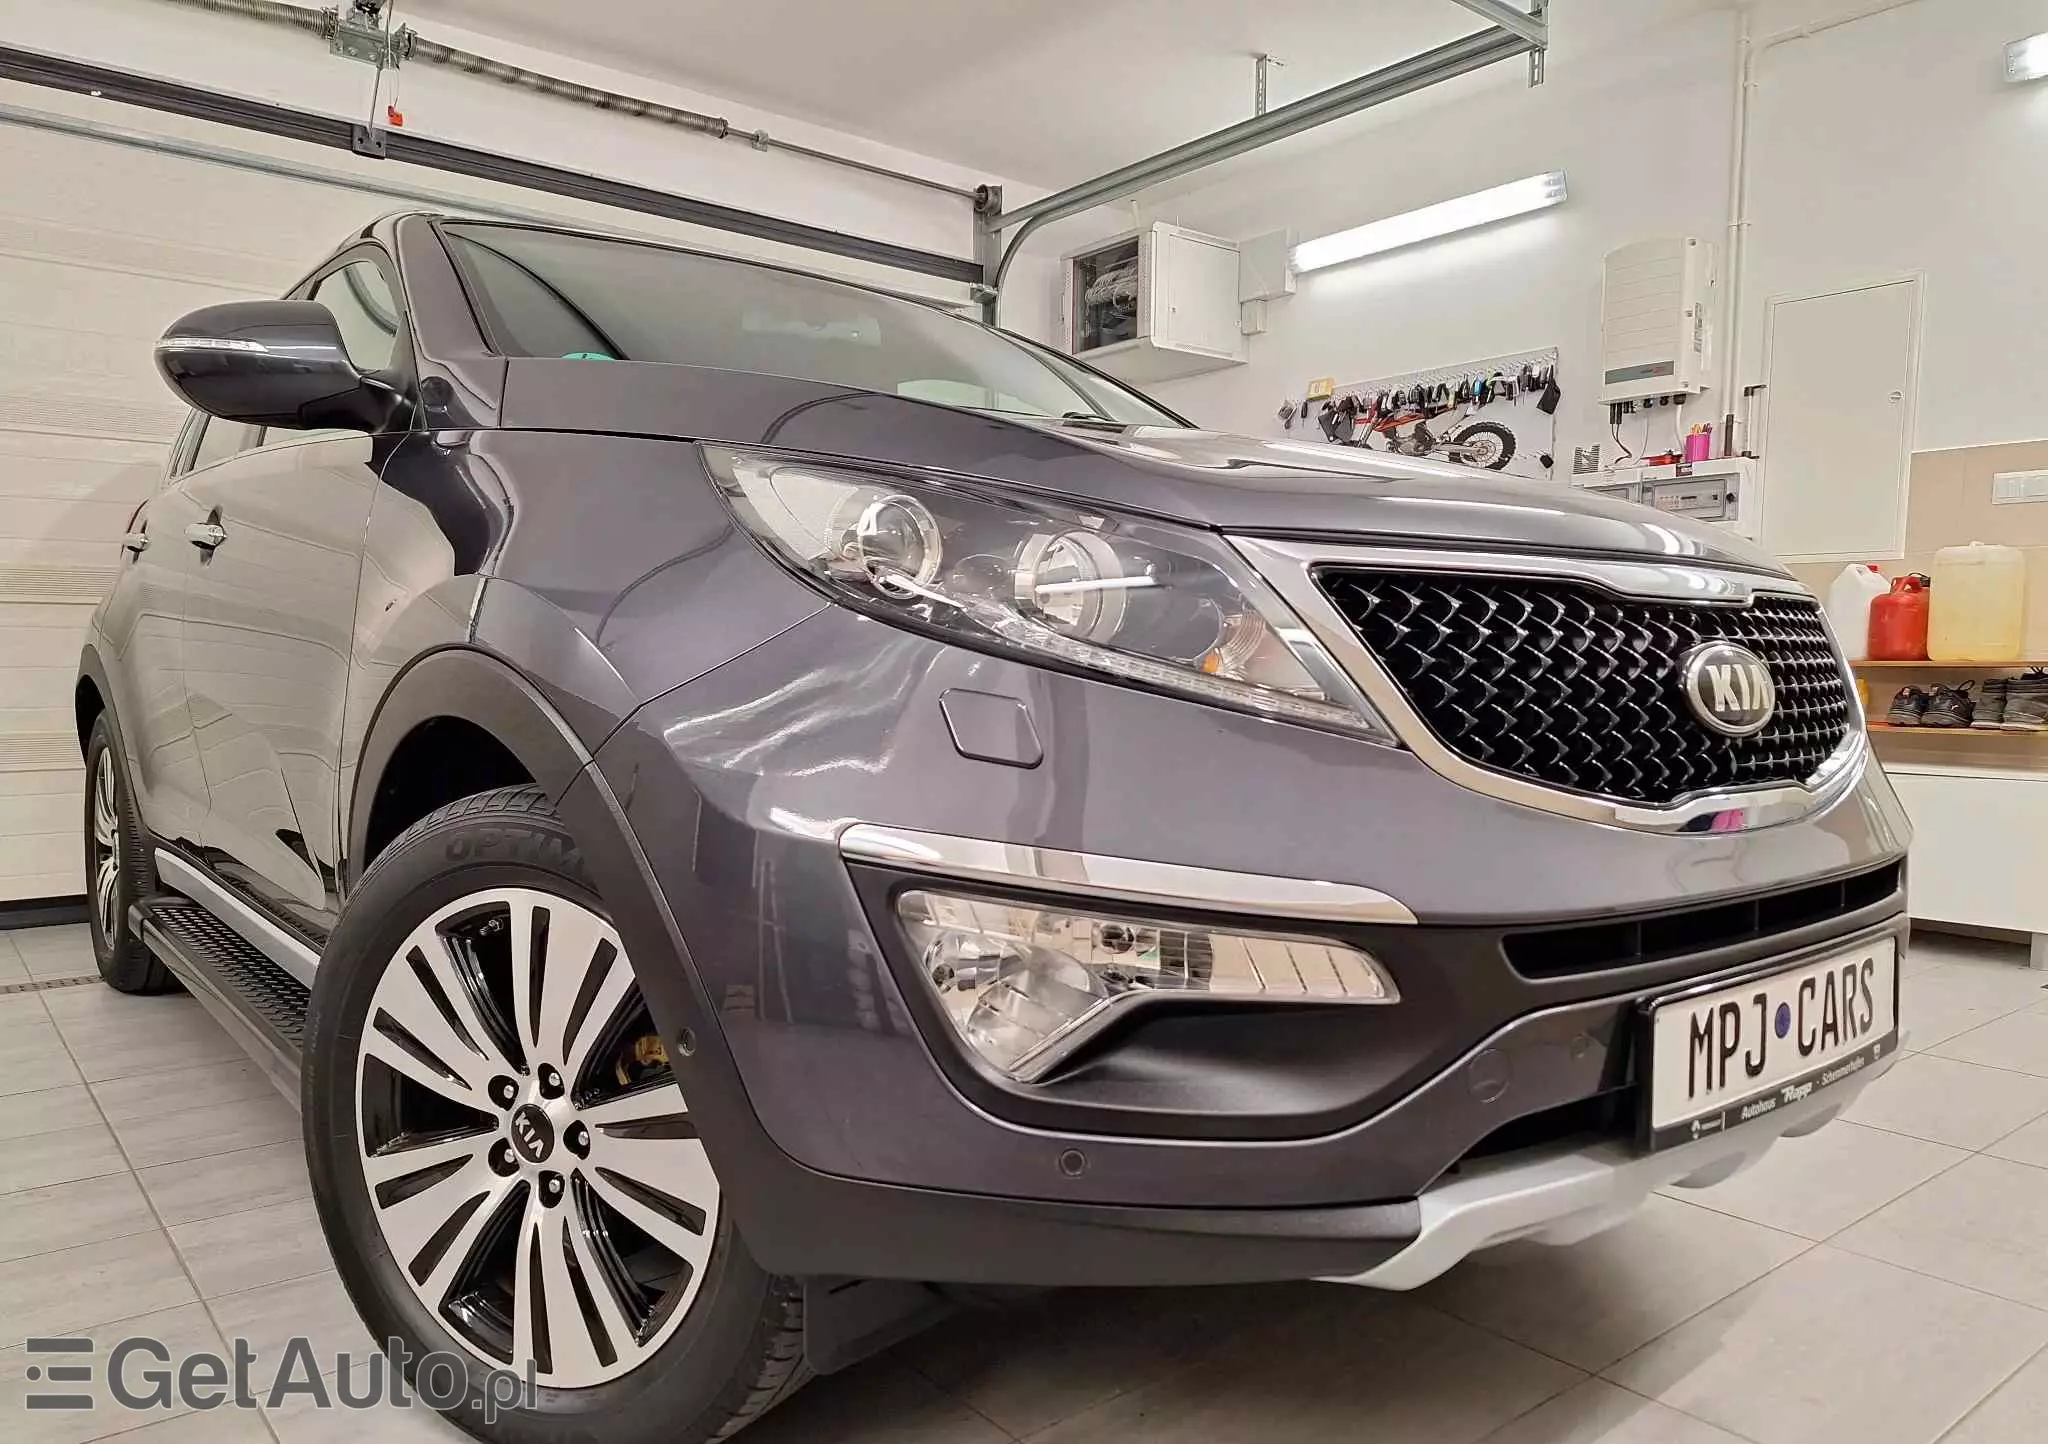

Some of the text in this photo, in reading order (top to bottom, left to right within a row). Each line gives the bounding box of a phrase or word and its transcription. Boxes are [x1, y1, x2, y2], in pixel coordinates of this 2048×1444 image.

[1704, 663, 1770, 712] KIA
[1687, 957, 1875, 1100] MPJ CARS
[1742, 1098, 1776, 1119] Autohaus
[515, 1111, 545, 1158] KIA
